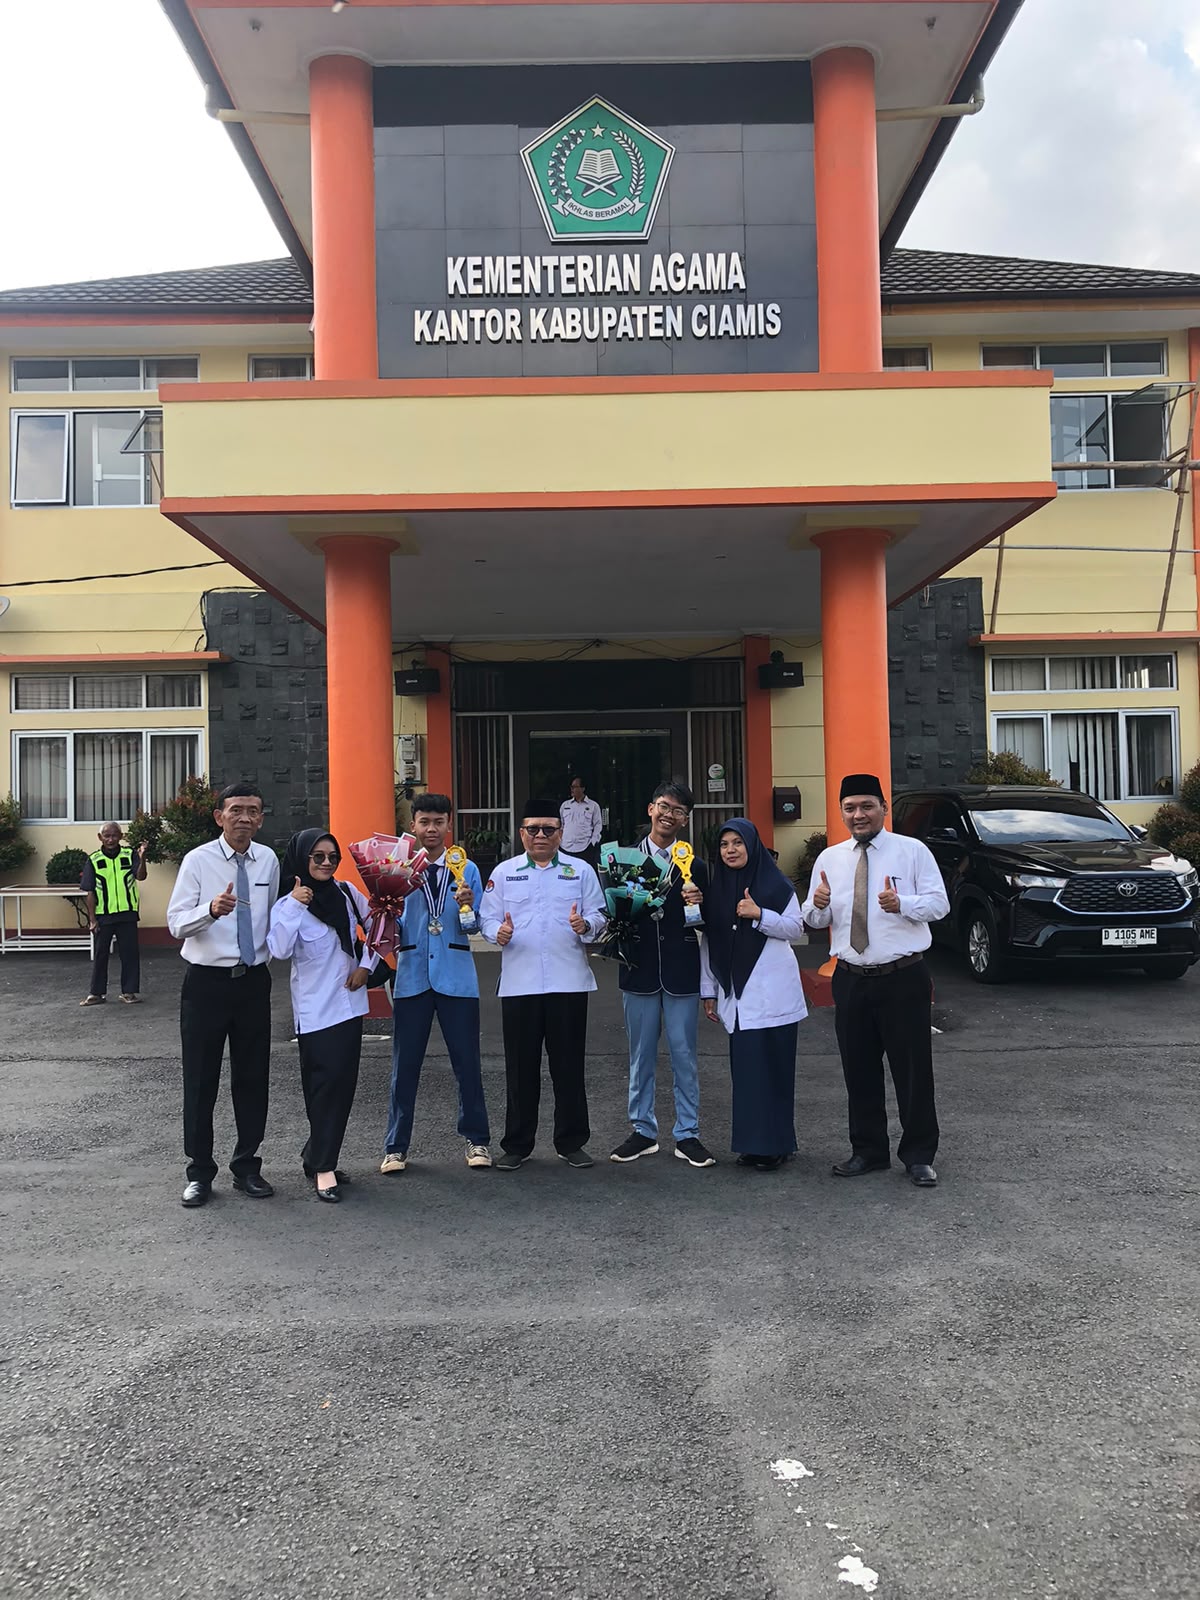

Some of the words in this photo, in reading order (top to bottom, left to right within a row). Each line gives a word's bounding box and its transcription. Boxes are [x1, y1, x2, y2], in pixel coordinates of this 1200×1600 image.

[567, 201, 594, 218] IKHLAS
[595, 202, 631, 218] BERAMAL
[447, 253, 641, 295] KEMENTERIAN
[649, 252, 747, 293] AGAMA
[414, 308, 522, 344] KANTOR
[529, 305, 683, 341] KABUPATEN
[691, 303, 782, 338] CIAMIS
[1104, 930, 1110, 940] D
[1115, 929, 1137, 939] 1105
[1140, 929, 1155, 939] AME
